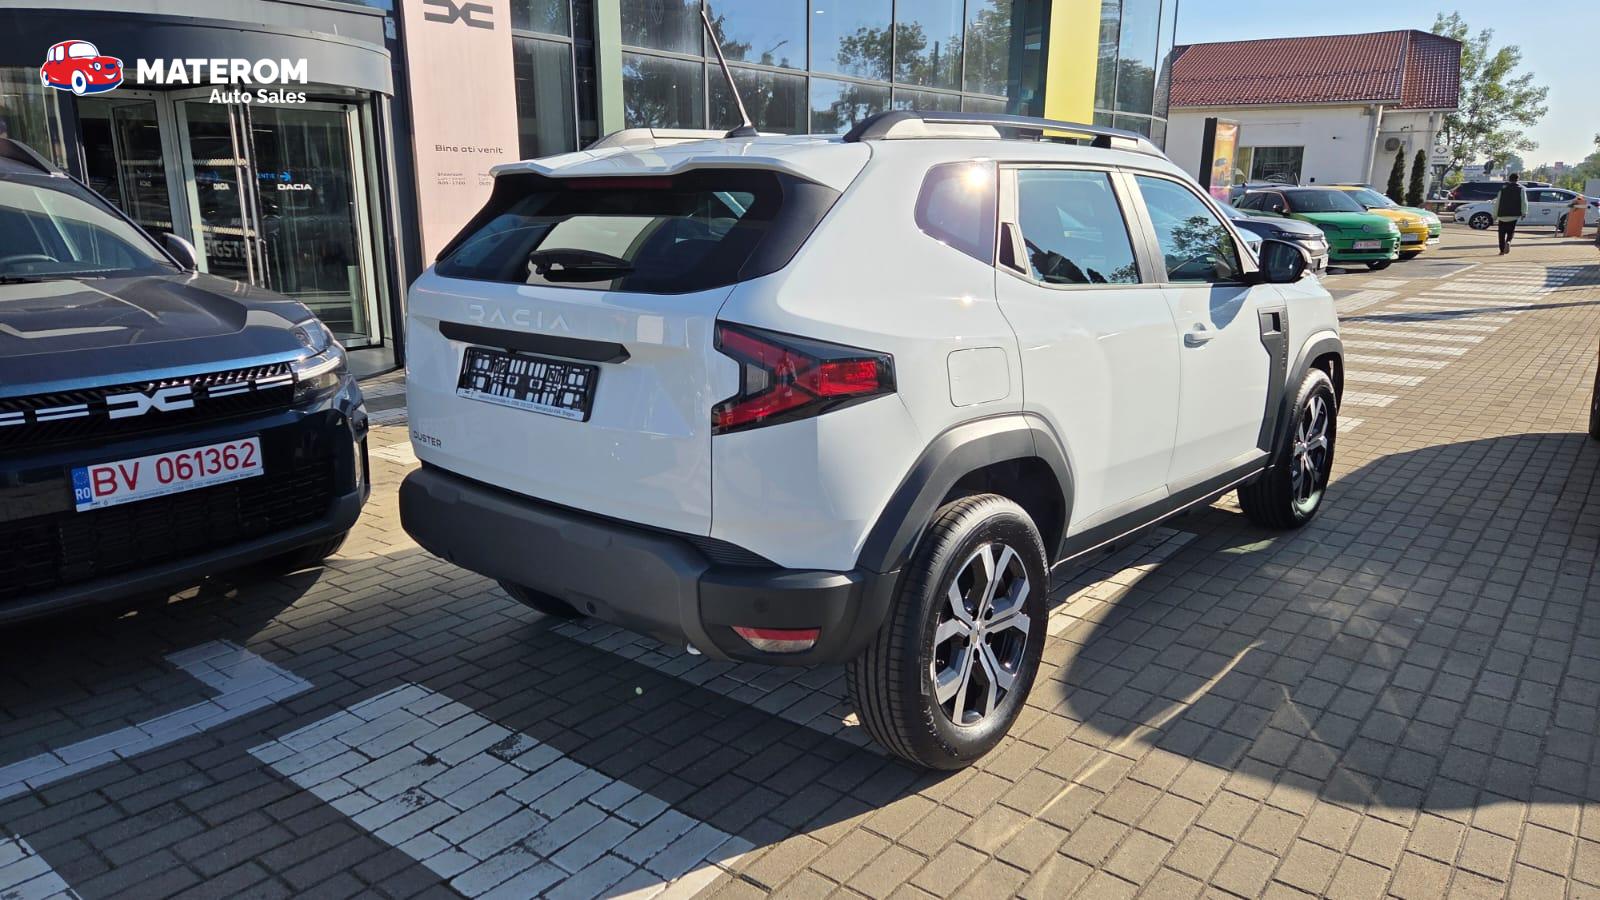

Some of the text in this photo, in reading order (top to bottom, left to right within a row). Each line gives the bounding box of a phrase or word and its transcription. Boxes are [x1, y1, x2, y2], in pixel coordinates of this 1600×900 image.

[435, 144, 458, 152] Bine
[478, 146, 503, 154] venit
[469, 303, 570, 331] DACIA
[413, 430, 442, 448] DUSTER
[75, 442, 257, 499] RO BV 061362
